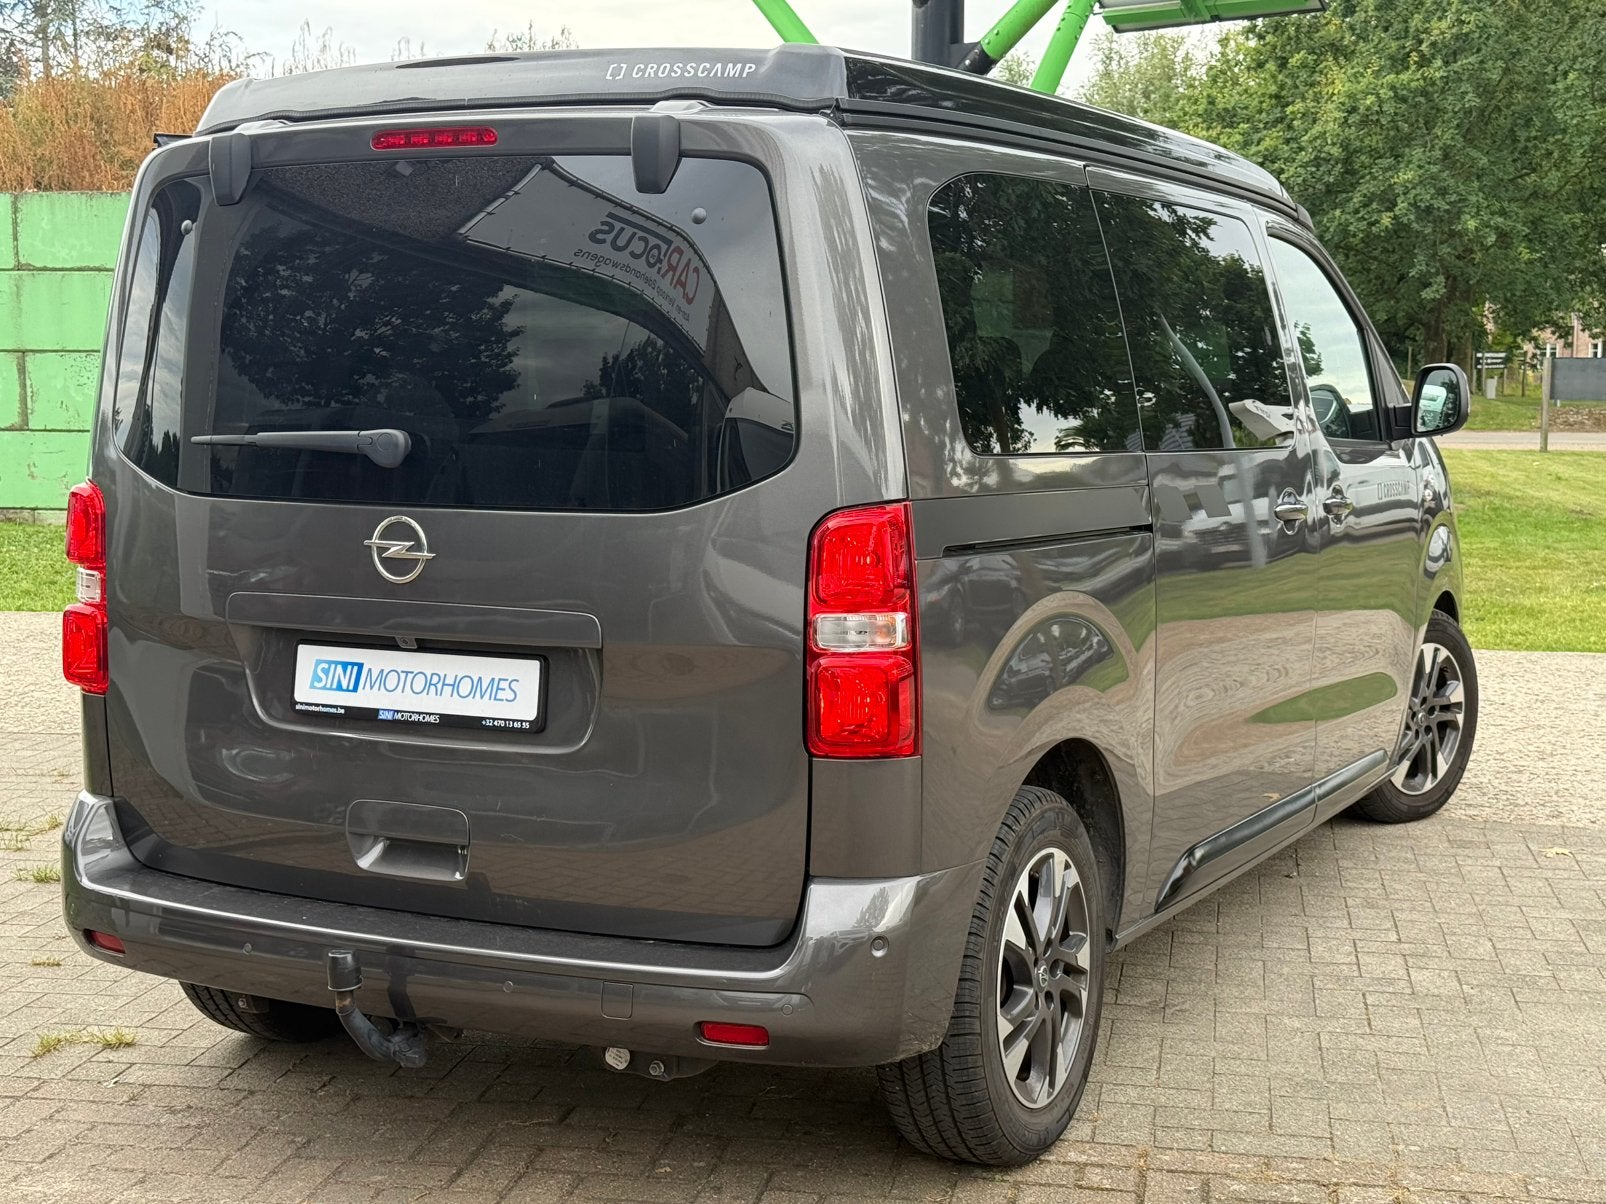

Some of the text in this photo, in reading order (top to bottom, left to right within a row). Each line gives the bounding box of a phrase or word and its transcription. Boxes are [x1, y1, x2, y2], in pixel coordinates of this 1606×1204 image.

[631, 62, 756, 78] CROSSCAMP
[312, 661, 520, 703] SINI MOTORHOMES
[295, 703, 345, 714] sinimotorhomes.be
[378, 710, 440, 723] SINI MOTORHOMES
[481, 719, 530, 729] +32 470 13 65 55
